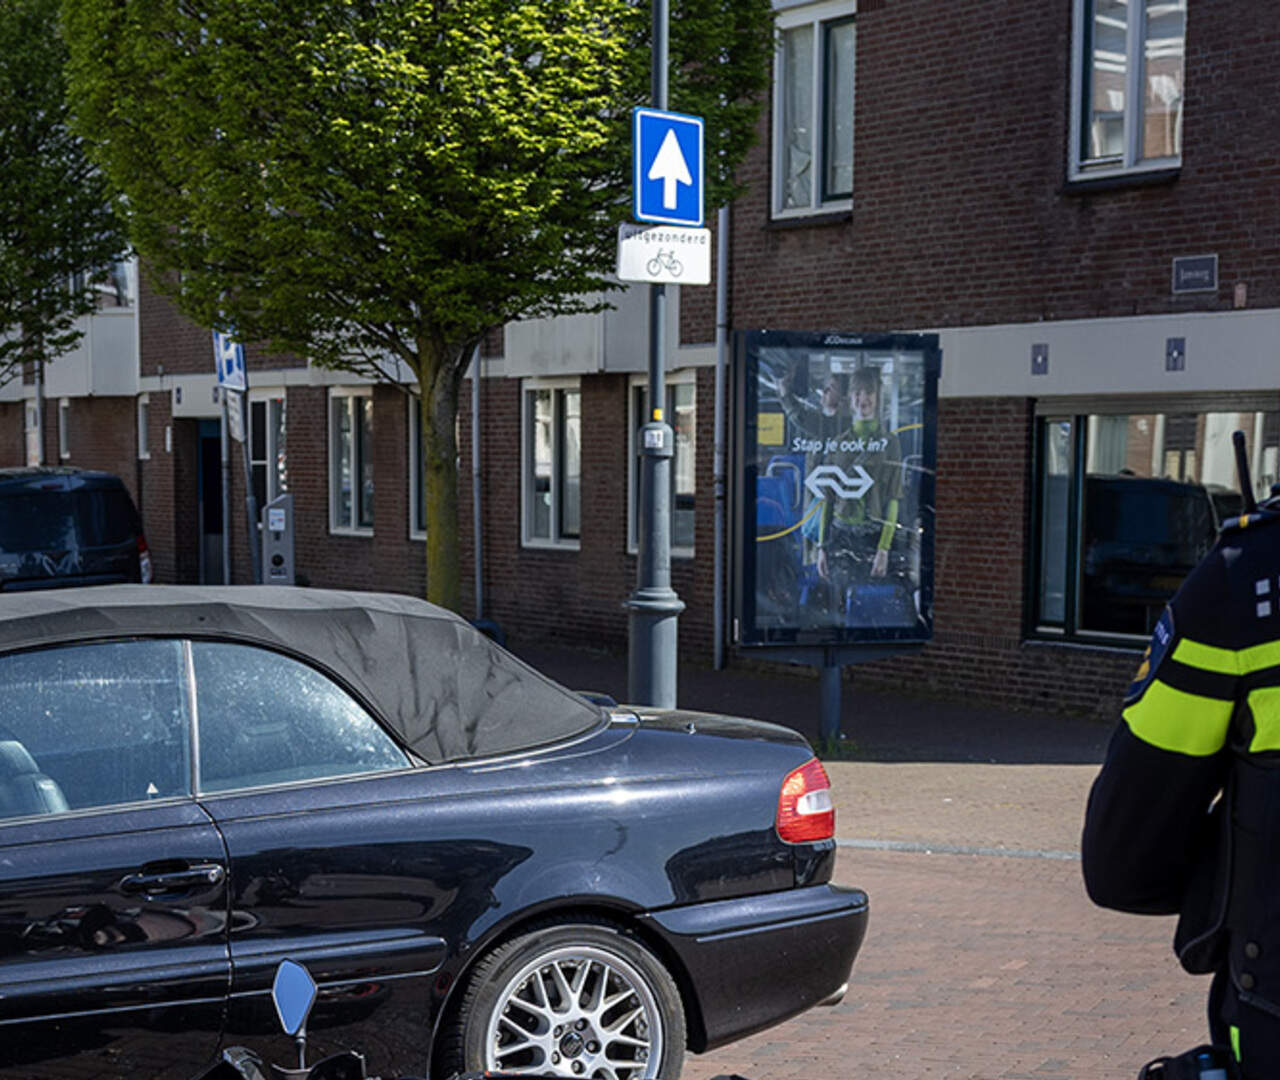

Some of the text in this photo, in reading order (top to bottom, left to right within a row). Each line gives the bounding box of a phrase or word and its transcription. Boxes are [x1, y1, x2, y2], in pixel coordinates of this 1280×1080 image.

[792, 437, 889, 455] Stap je ook in?
